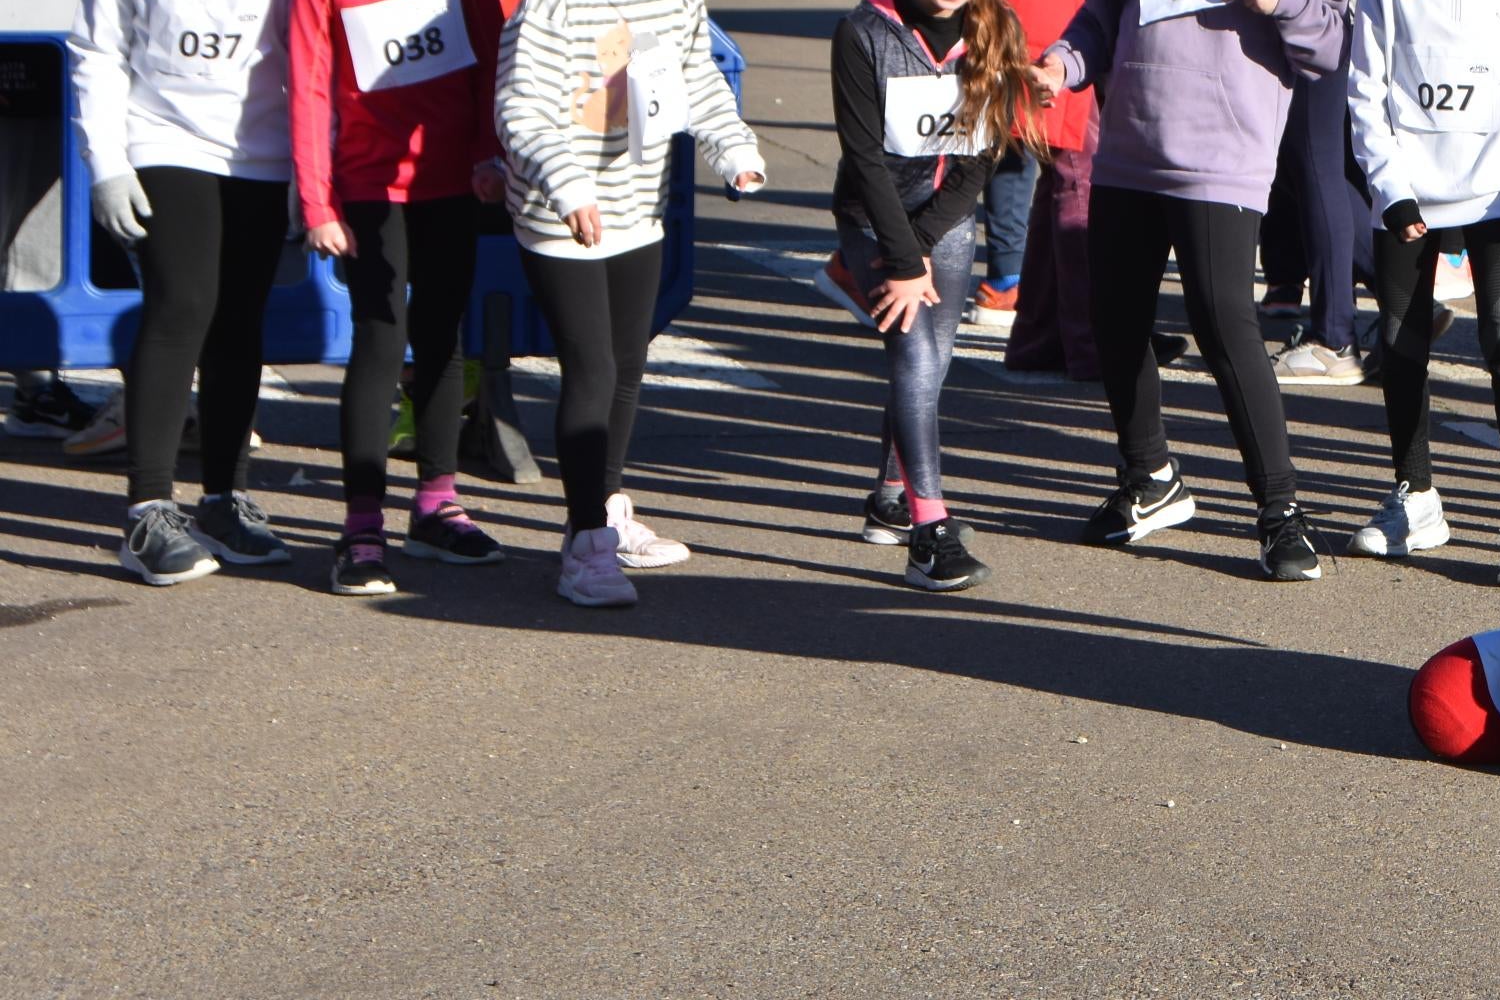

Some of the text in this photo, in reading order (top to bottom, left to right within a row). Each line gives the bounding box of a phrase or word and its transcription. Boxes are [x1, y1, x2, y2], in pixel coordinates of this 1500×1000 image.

[179, 31, 242, 59] 037
[383, 26, 444, 66] 038
[1417, 82, 1475, 111] 027
[917, 113, 967, 137] 02
